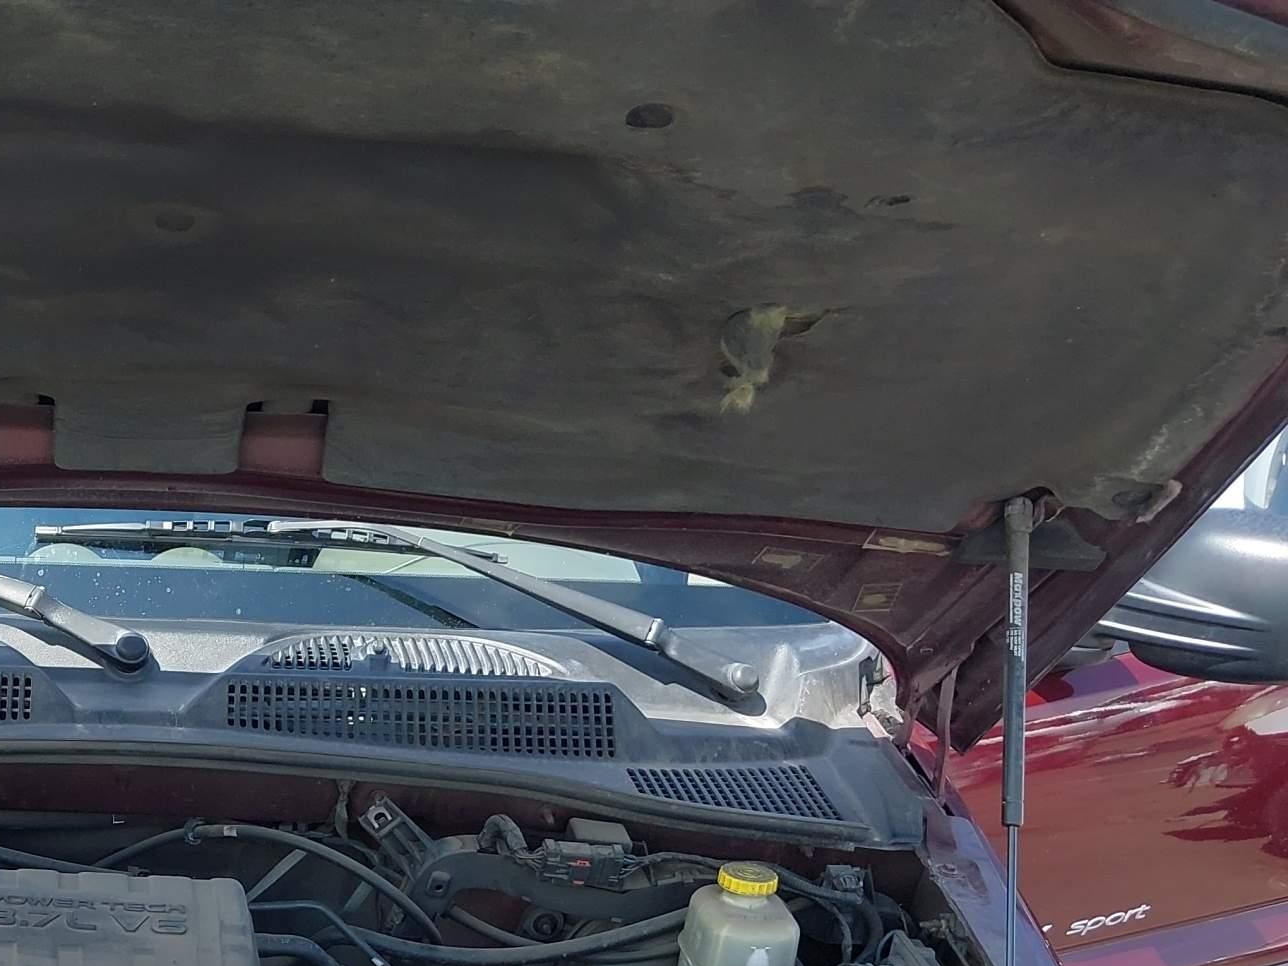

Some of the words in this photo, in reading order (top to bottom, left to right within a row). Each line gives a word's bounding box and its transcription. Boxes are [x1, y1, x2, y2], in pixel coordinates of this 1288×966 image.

[101, 901, 187, 914] TECH
[111, 914, 188, 936] V6
[1066, 903, 1152, 936] sport
